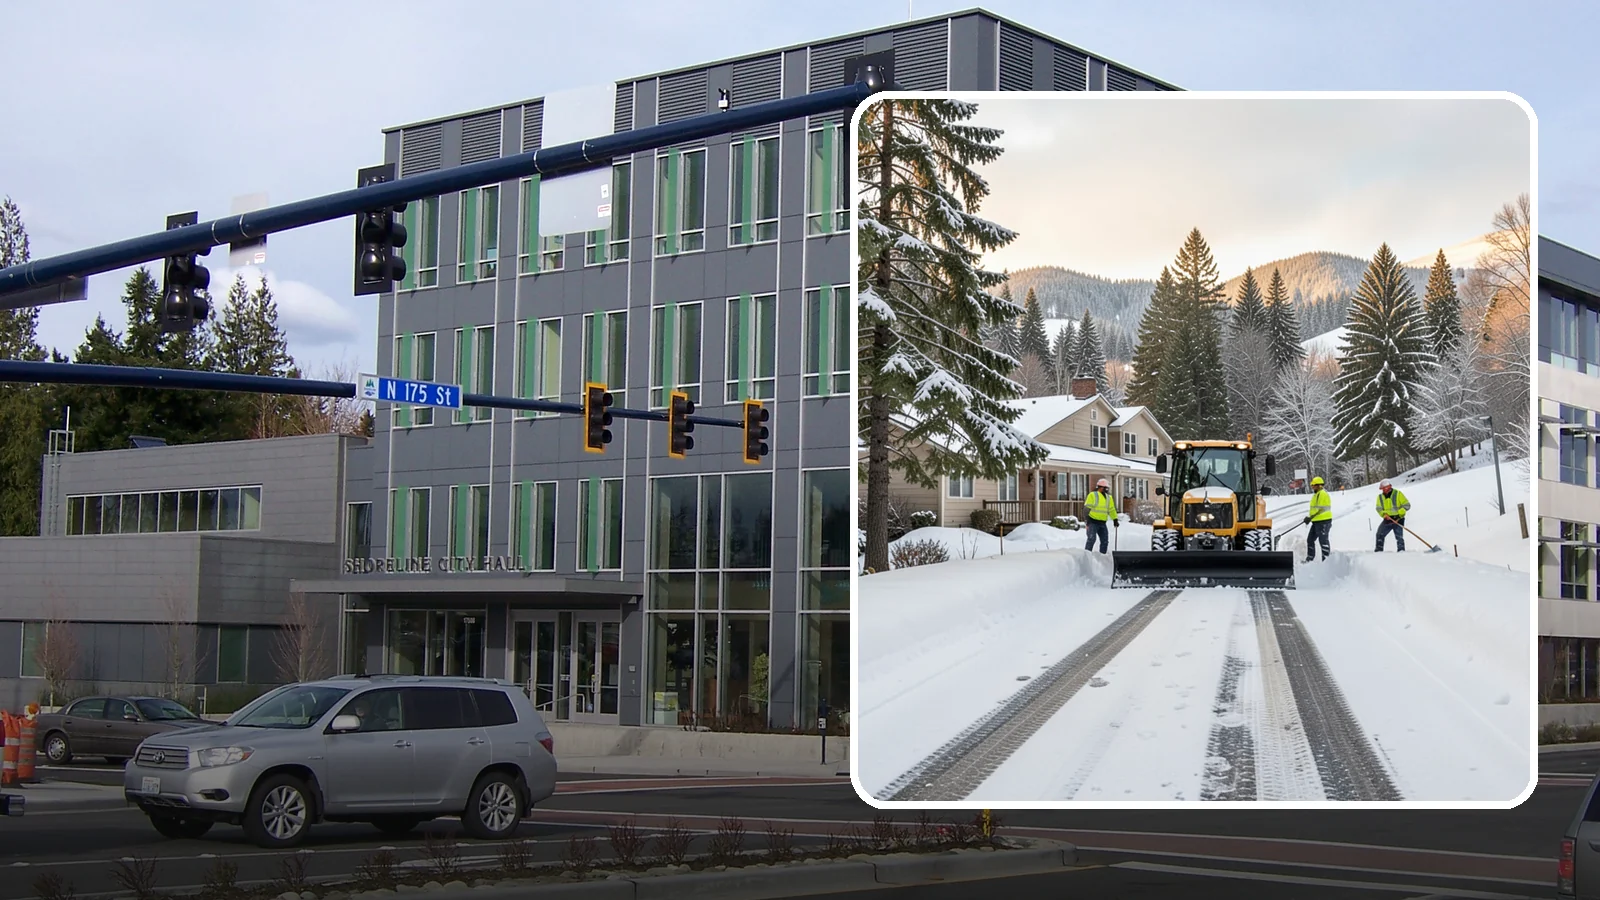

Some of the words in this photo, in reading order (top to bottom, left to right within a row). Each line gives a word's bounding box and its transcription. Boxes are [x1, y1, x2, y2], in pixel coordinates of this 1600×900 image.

[387, 380, 396, 400] N
[405, 382, 427, 403] 175
[436, 386, 451, 406] St
[344, 556, 432, 573] SHORELINE
[438, 555, 477, 573] CITY
[483, 555, 526, 572] HALL
